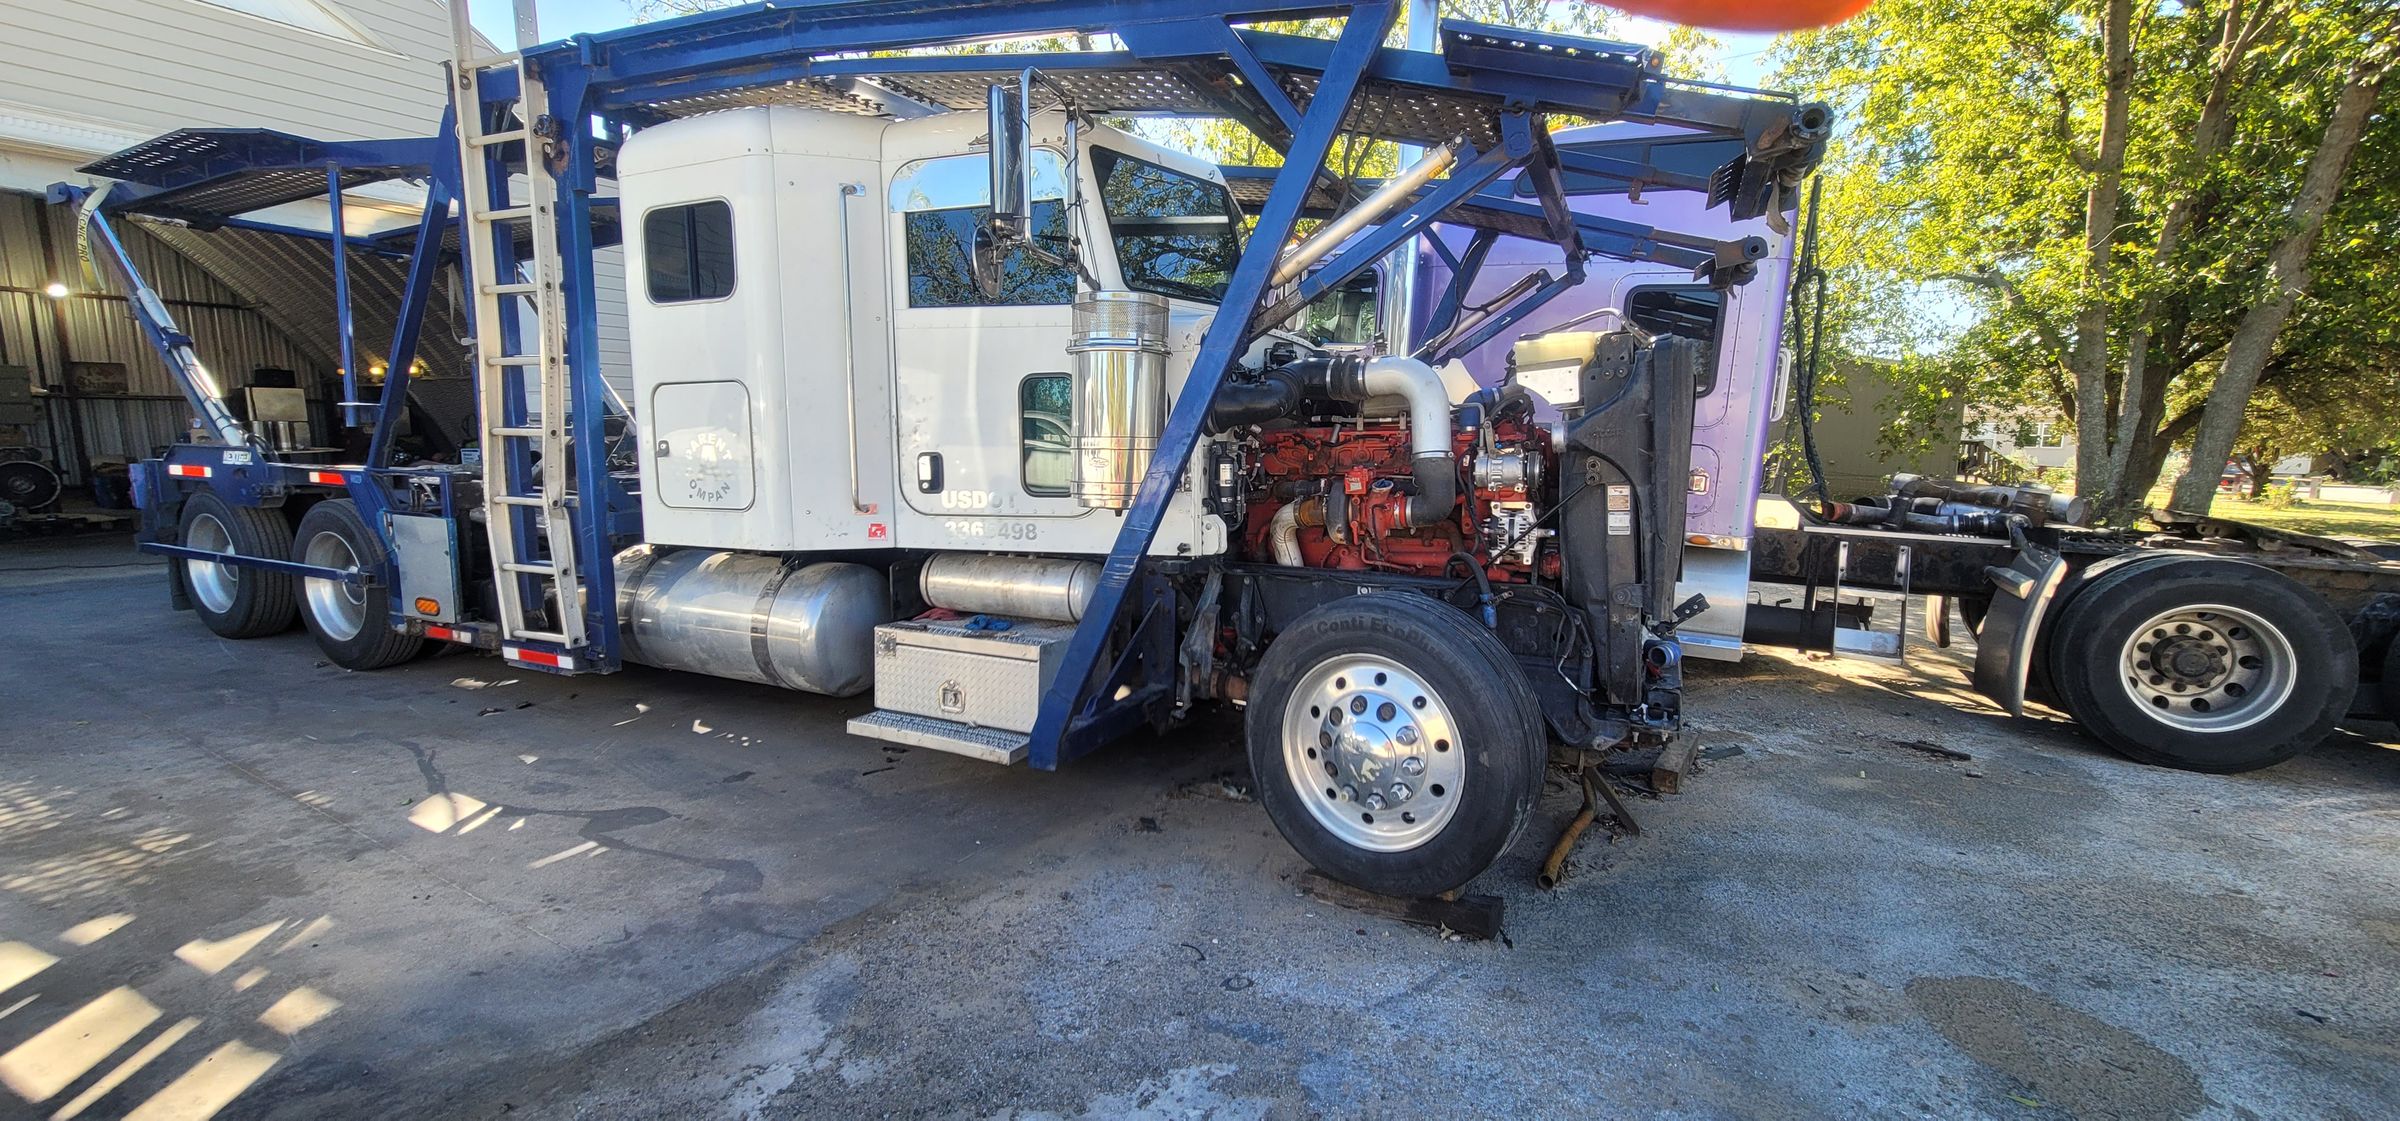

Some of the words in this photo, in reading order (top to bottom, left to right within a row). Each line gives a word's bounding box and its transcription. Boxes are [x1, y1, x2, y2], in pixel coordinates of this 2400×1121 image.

[1402, 213, 1419, 228] 1
[78, 243, 90, 262] PRO
[1316, 616, 1363, 635] Conti
